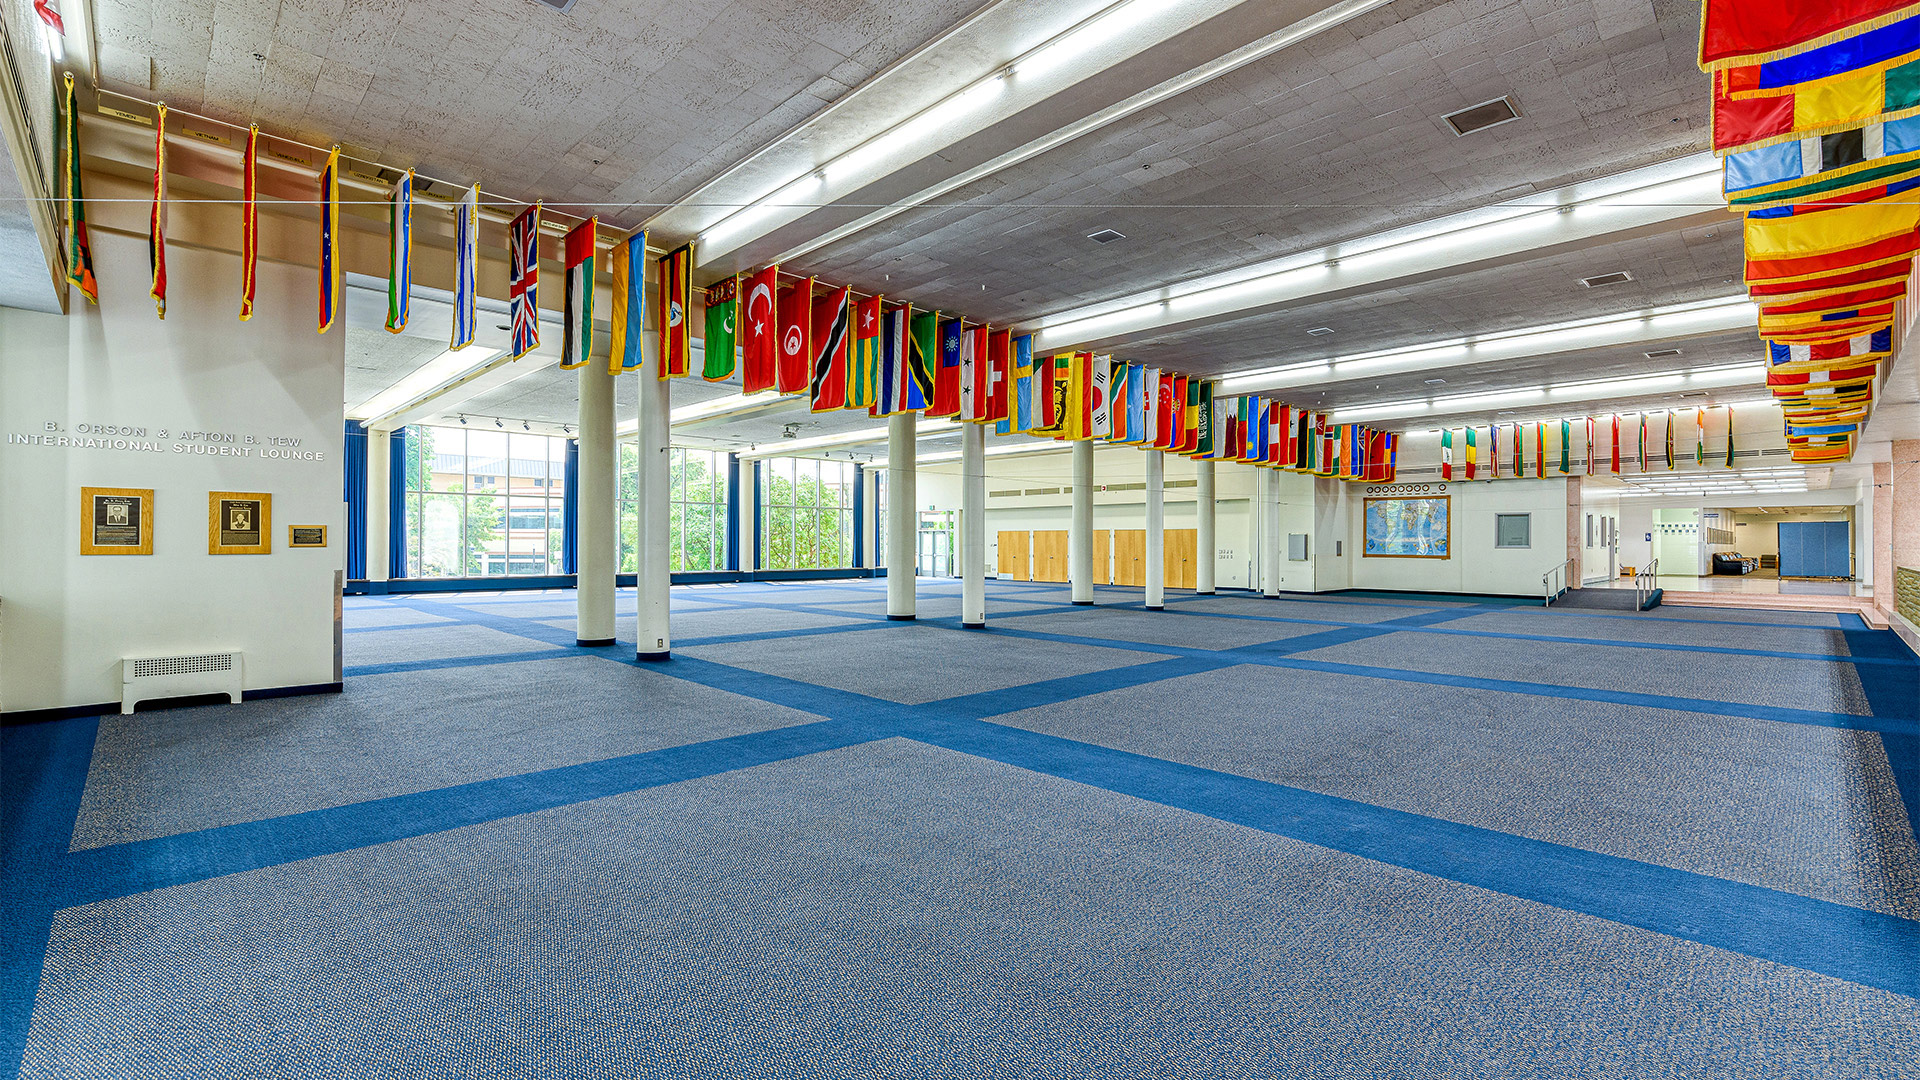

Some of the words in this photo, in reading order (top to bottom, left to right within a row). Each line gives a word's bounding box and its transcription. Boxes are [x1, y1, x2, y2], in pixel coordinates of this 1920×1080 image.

[115, 111, 136, 120] YEMEN
[195, 131, 219, 141] VIETNAM
[44, 421, 65, 432] B.
[76, 422, 147, 437] ORSON
[157, 428, 169, 439] &
[179, 431, 235, 443] AFTON
[244, 435, 261, 445] B.
[268, 436, 301, 447] TEW
[8, 433, 164, 452] INTERNATIONAL
[172, 443, 252, 457] STUDENT
[260, 448, 325, 461] LOUNGE
